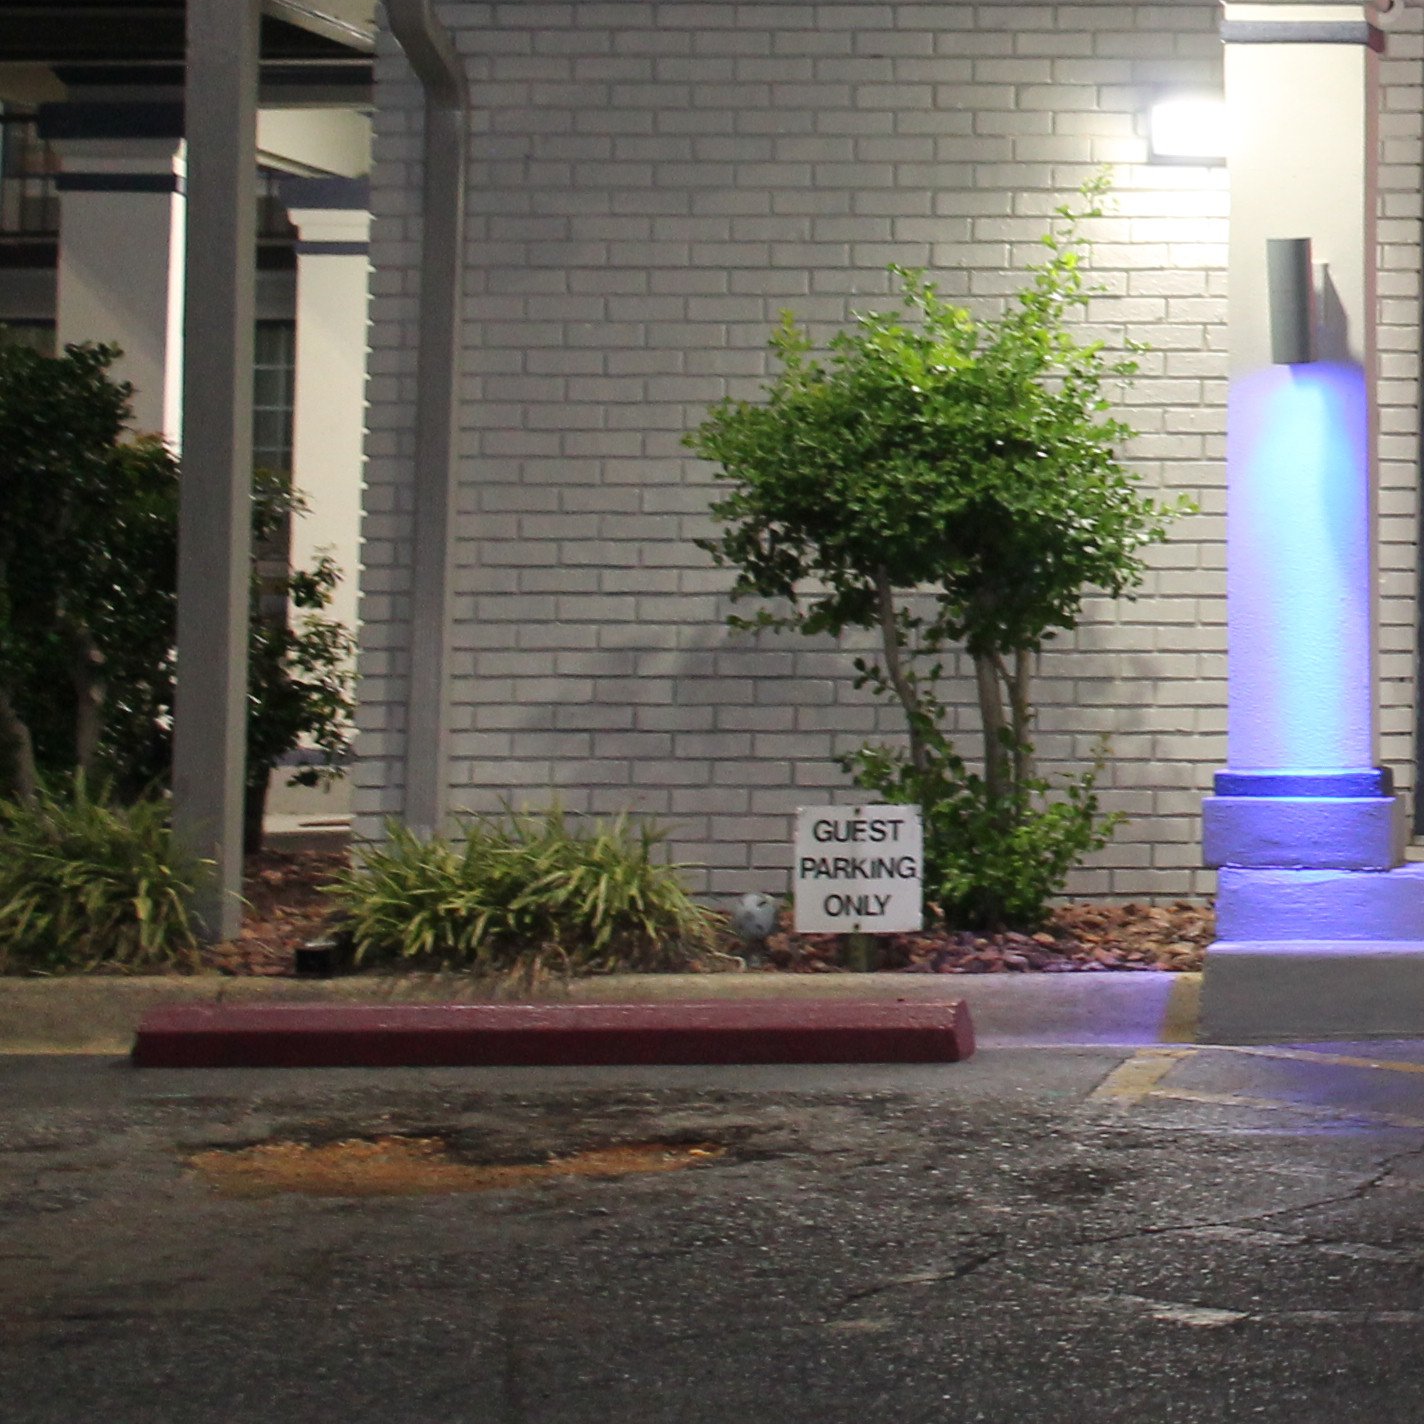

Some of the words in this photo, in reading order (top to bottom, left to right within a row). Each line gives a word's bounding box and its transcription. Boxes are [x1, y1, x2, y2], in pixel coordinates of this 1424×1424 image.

[813, 819, 904, 842] GUEST
[800, 855, 917, 880] PARKING
[823, 893, 892, 917] ONLY
